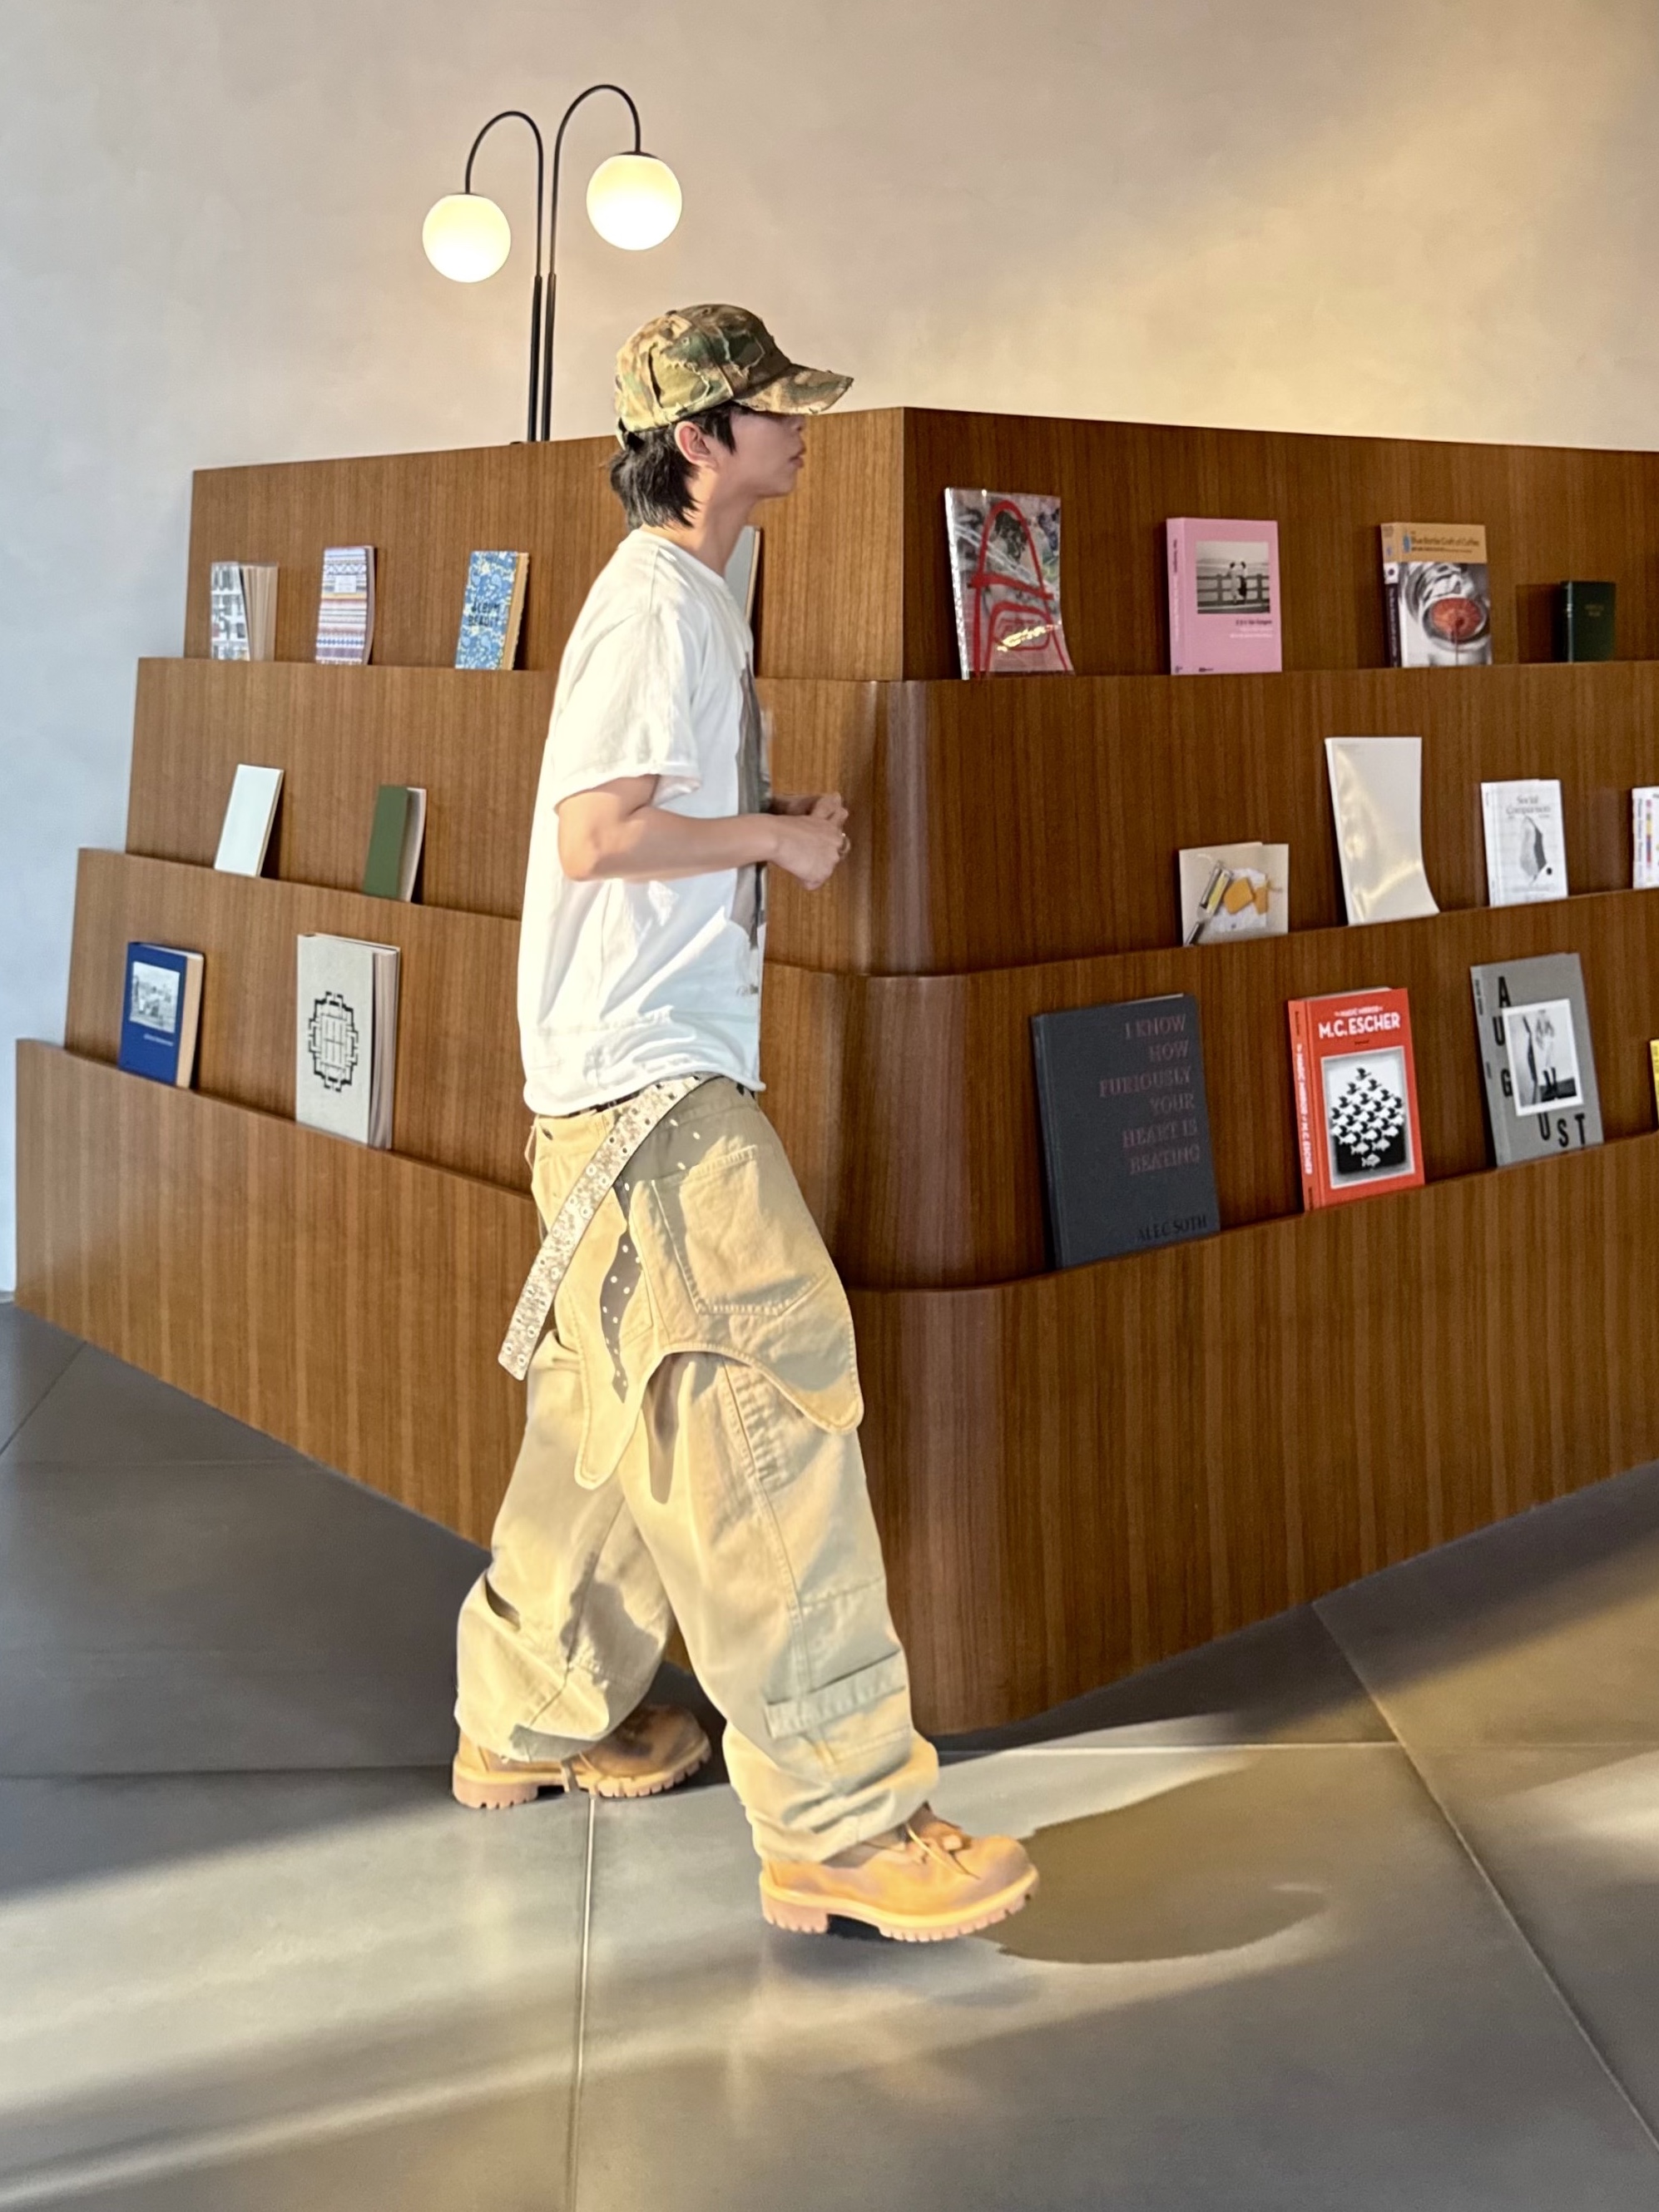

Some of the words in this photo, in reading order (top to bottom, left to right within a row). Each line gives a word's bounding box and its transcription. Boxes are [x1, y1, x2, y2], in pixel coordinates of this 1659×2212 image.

[1136, 1014, 1186, 1037] KNOW
[1319, 1019, 1347, 1039] M.C.
[1349, 1012, 1400, 1035] ESCHER
[1149, 1038, 1190, 1063] HOW
[1100, 1068, 1191, 1097] FURIOUSLY
[1149, 1093, 1195, 1116] YOUR
[1123, 1123, 1178, 1148] HEART
[1182, 1119, 1198, 1137] IS
[1130, 1143, 1201, 1175] BEATING
[1137, 1221, 1171, 1241] ALEC
[1173, 1214, 1207, 1234] SOTH
